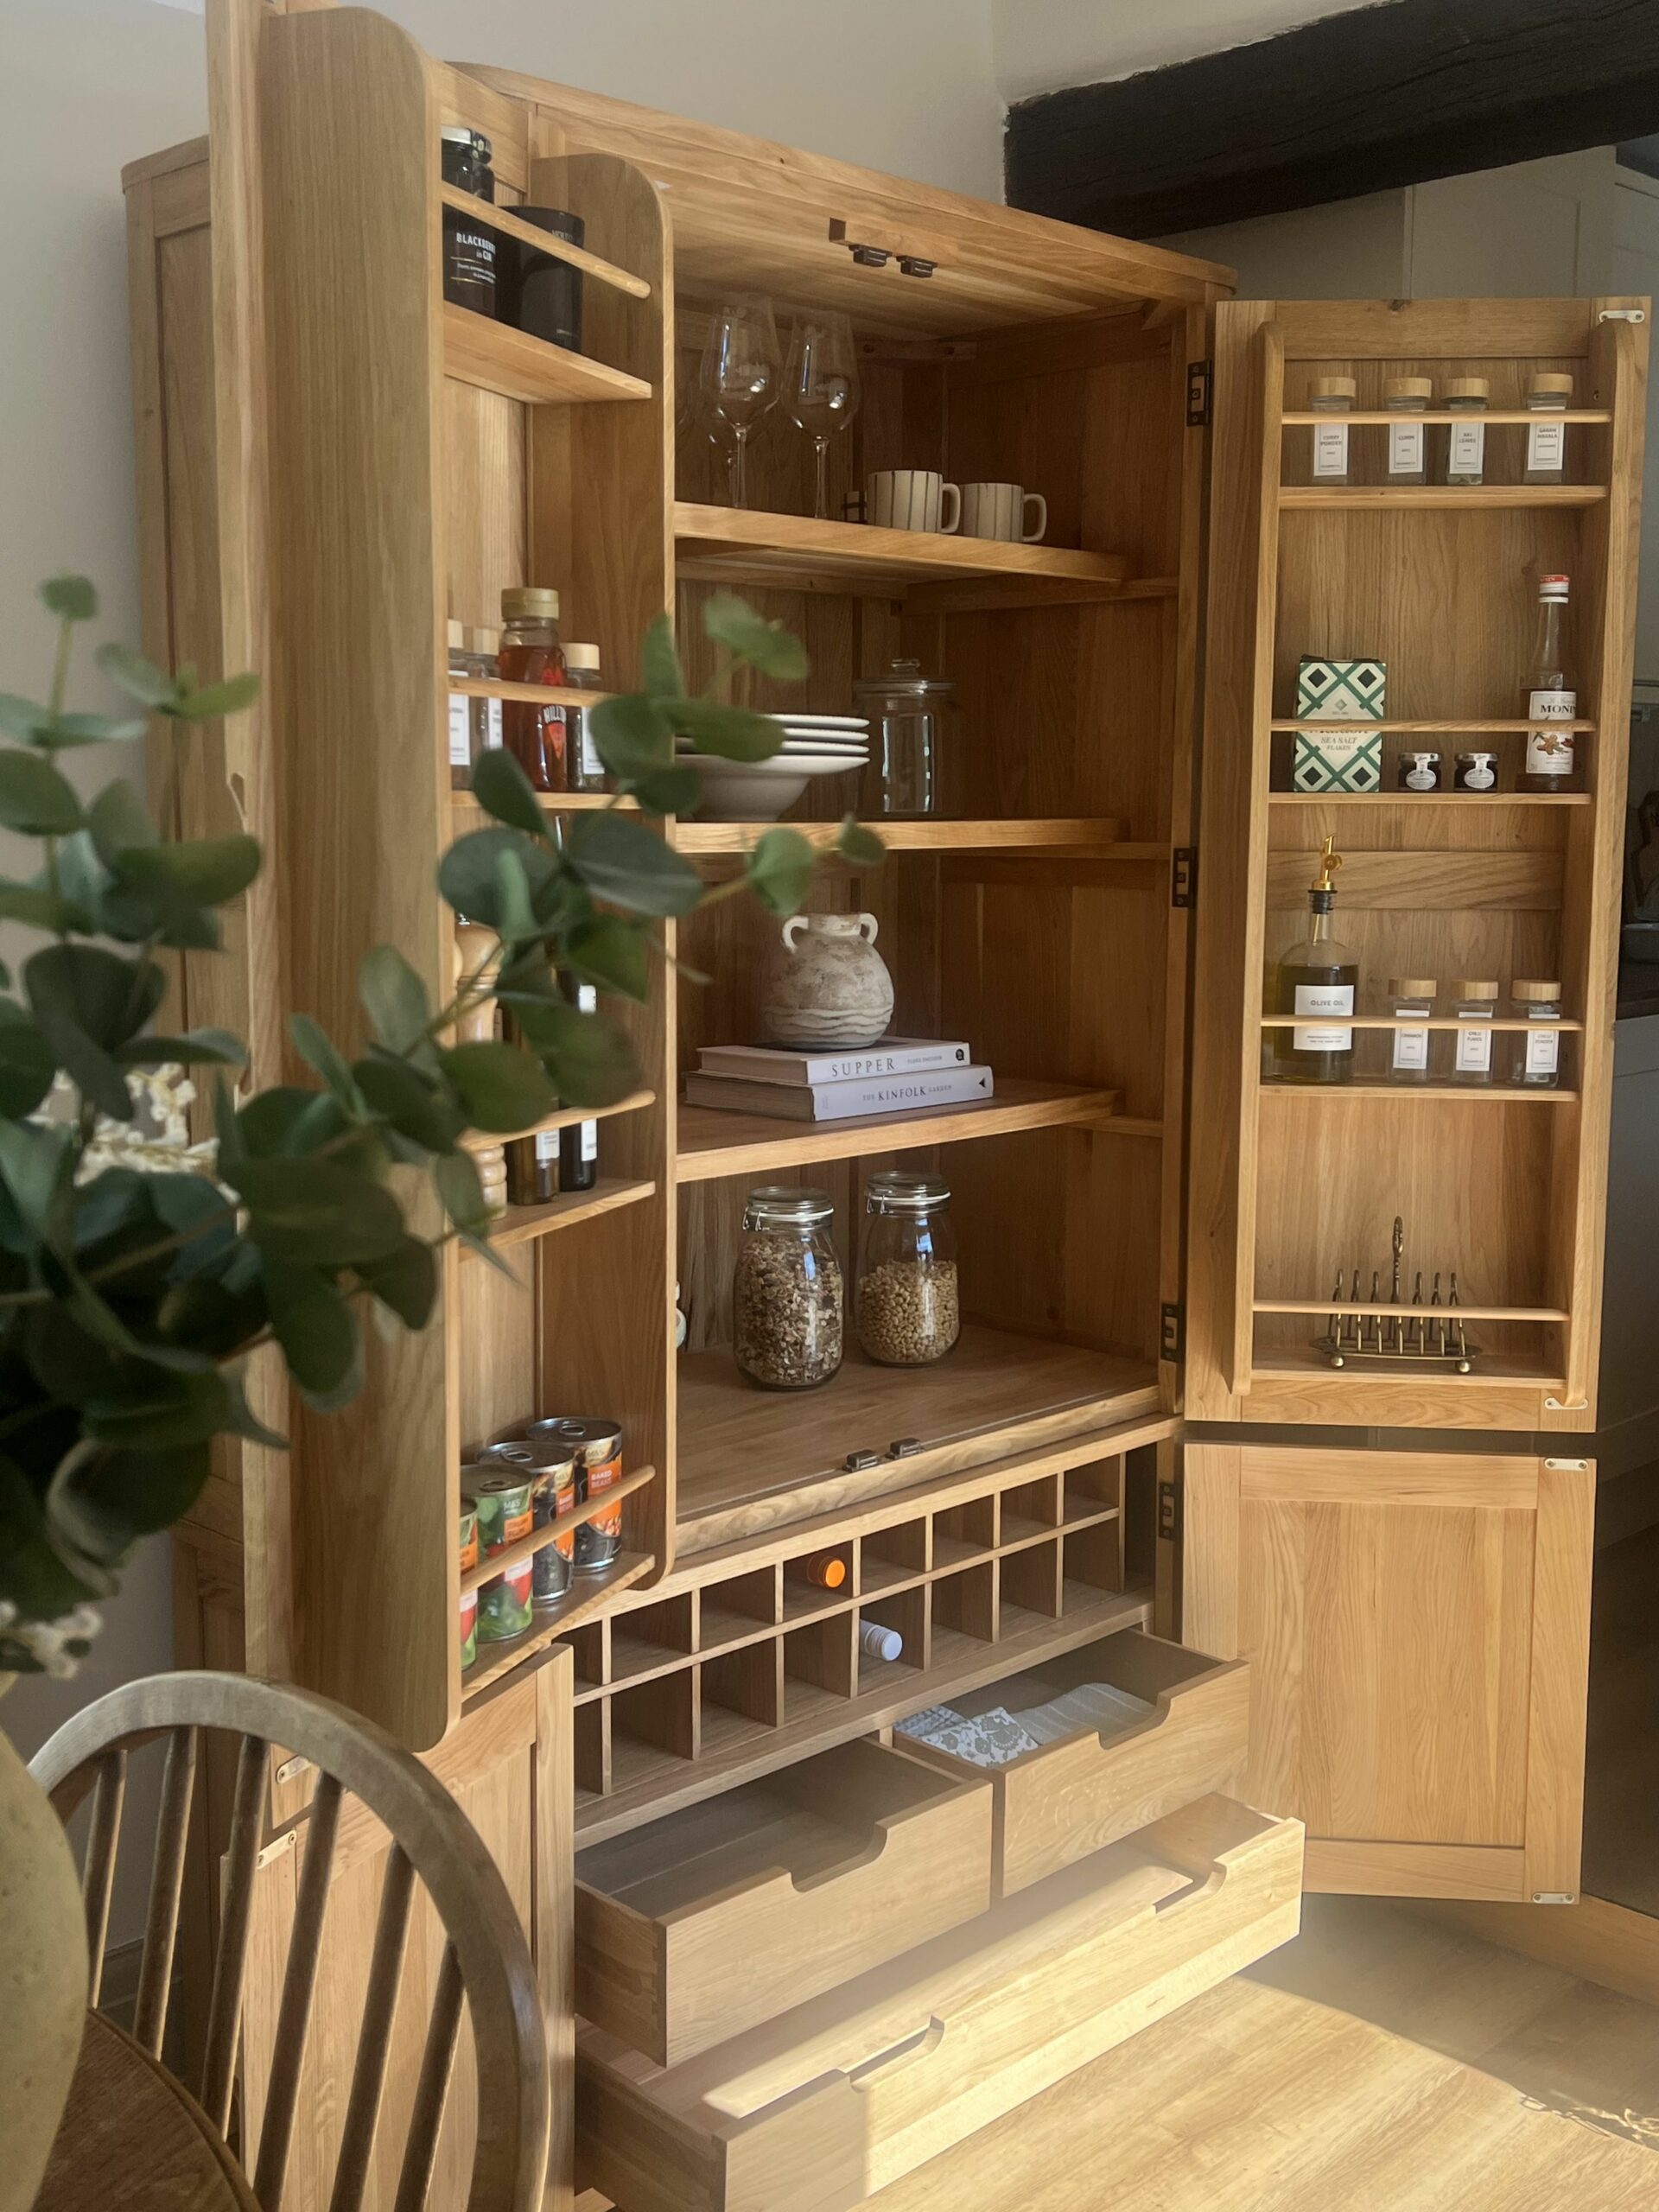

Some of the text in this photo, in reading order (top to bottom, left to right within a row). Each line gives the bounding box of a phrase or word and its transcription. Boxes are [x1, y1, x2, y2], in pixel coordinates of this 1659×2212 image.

[831, 1058, 895, 1077] SUPPER
[878, 1085, 926, 1102] KINFOLK
[591, 1469, 613, 1481] BAKED
[503, 1498, 521, 1510] M&S
